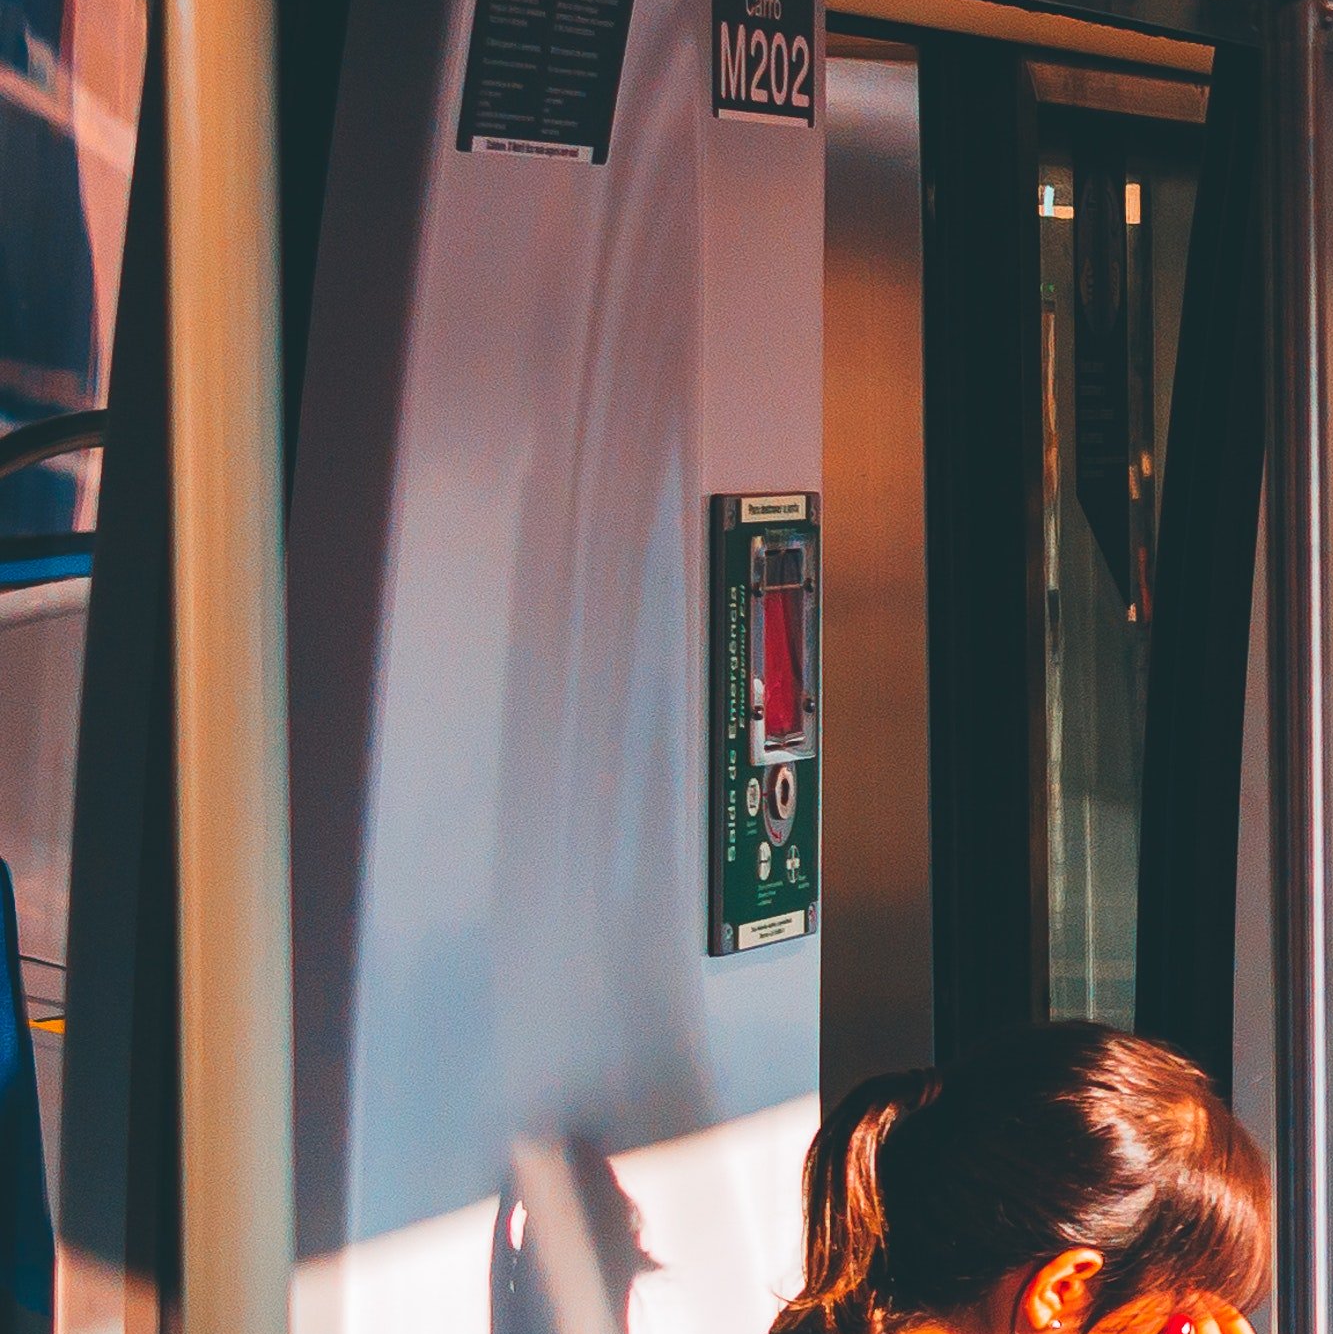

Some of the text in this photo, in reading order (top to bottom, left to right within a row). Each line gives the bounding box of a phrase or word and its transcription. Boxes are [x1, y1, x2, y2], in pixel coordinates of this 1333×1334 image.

[720, 21, 810, 108] M202
[728, 586, 738, 739] Emergência
[728, 749, 738, 781] de
